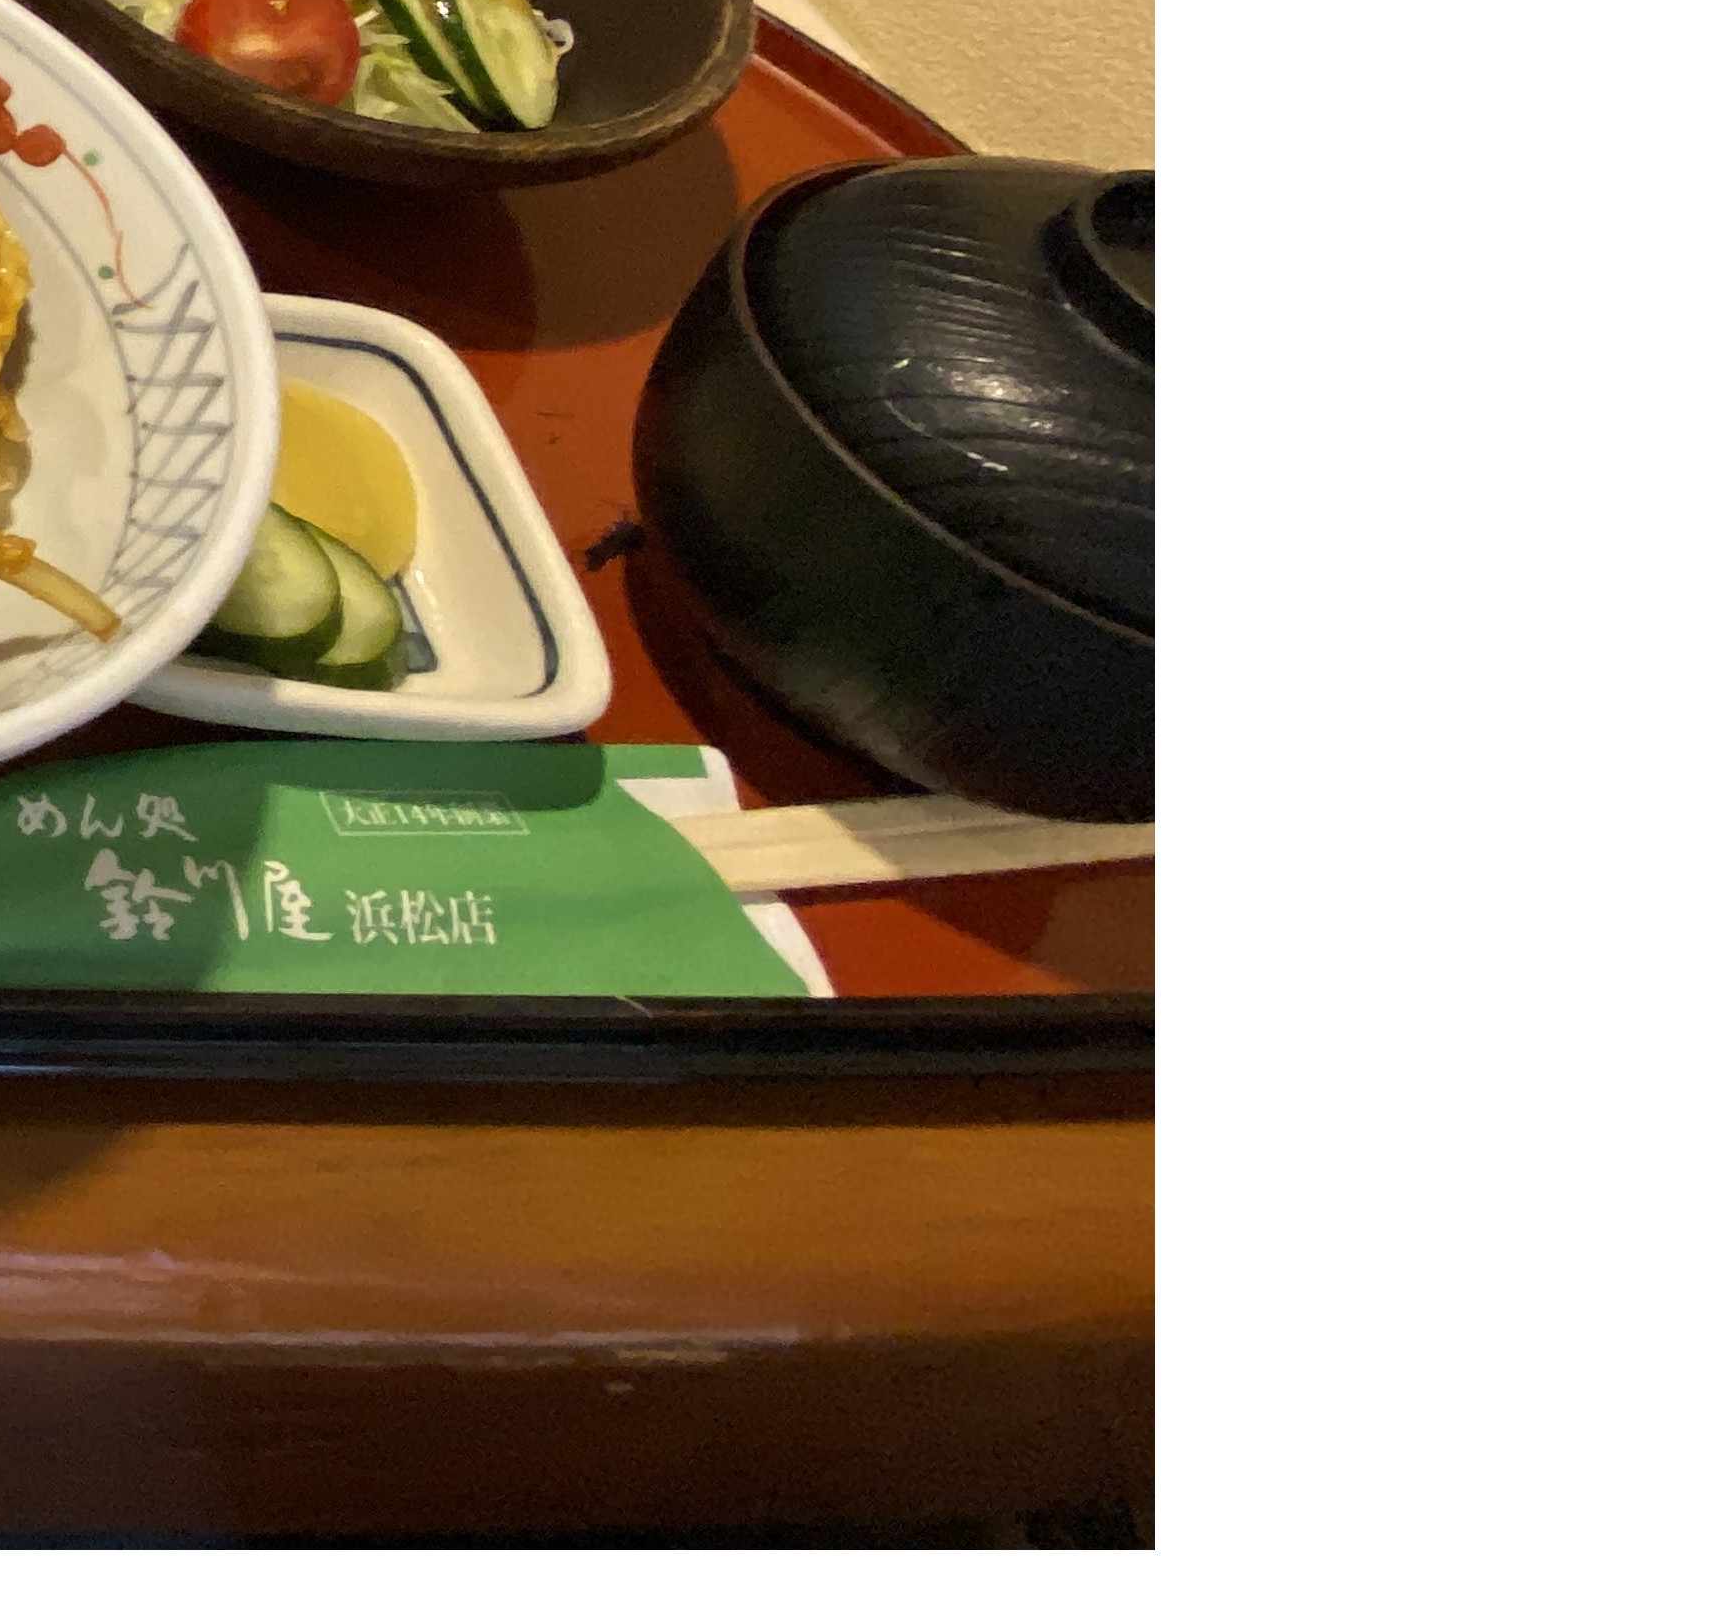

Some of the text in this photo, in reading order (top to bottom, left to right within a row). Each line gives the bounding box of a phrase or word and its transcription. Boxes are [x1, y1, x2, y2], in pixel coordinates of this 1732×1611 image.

[16, 791, 198, 843] めん処
[82, 847, 497, 946] 鈴川屋 浜松店
